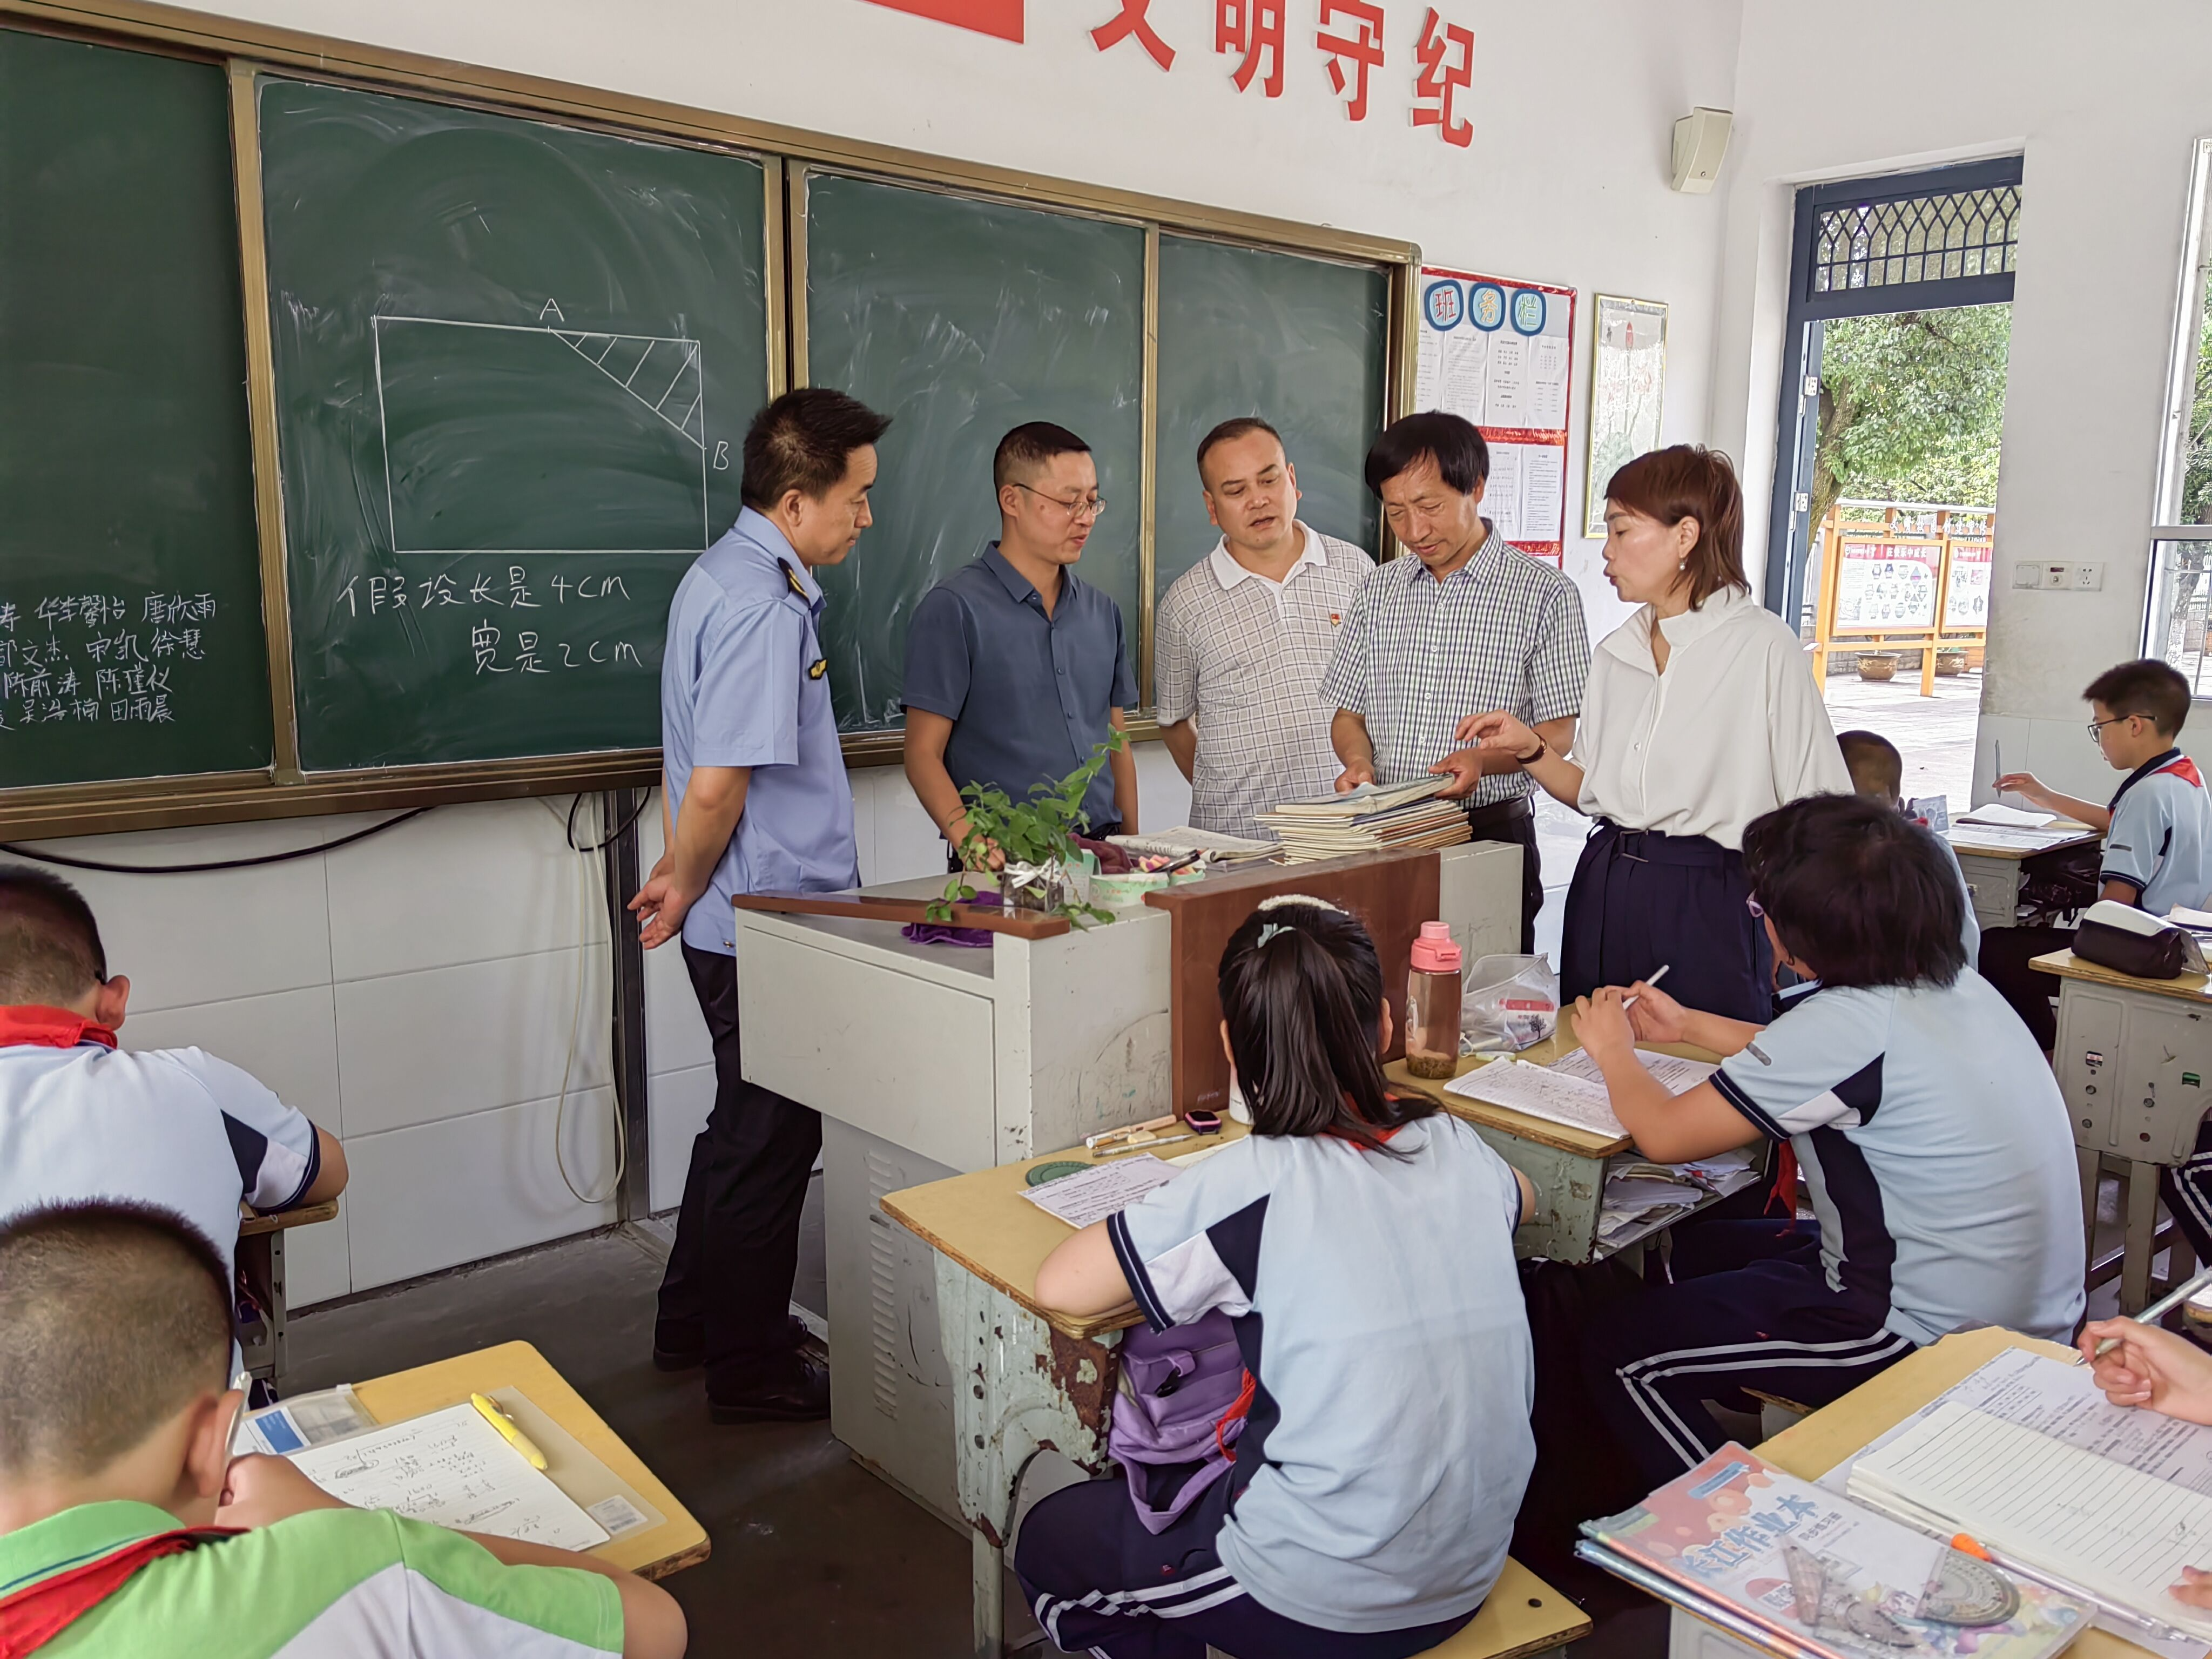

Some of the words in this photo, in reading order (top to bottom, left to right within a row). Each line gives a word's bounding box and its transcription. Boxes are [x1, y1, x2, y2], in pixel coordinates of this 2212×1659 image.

[540, 299, 564, 322] A
[1435, 289, 1538, 327] 班务栏
[713, 441, 729, 470] B
